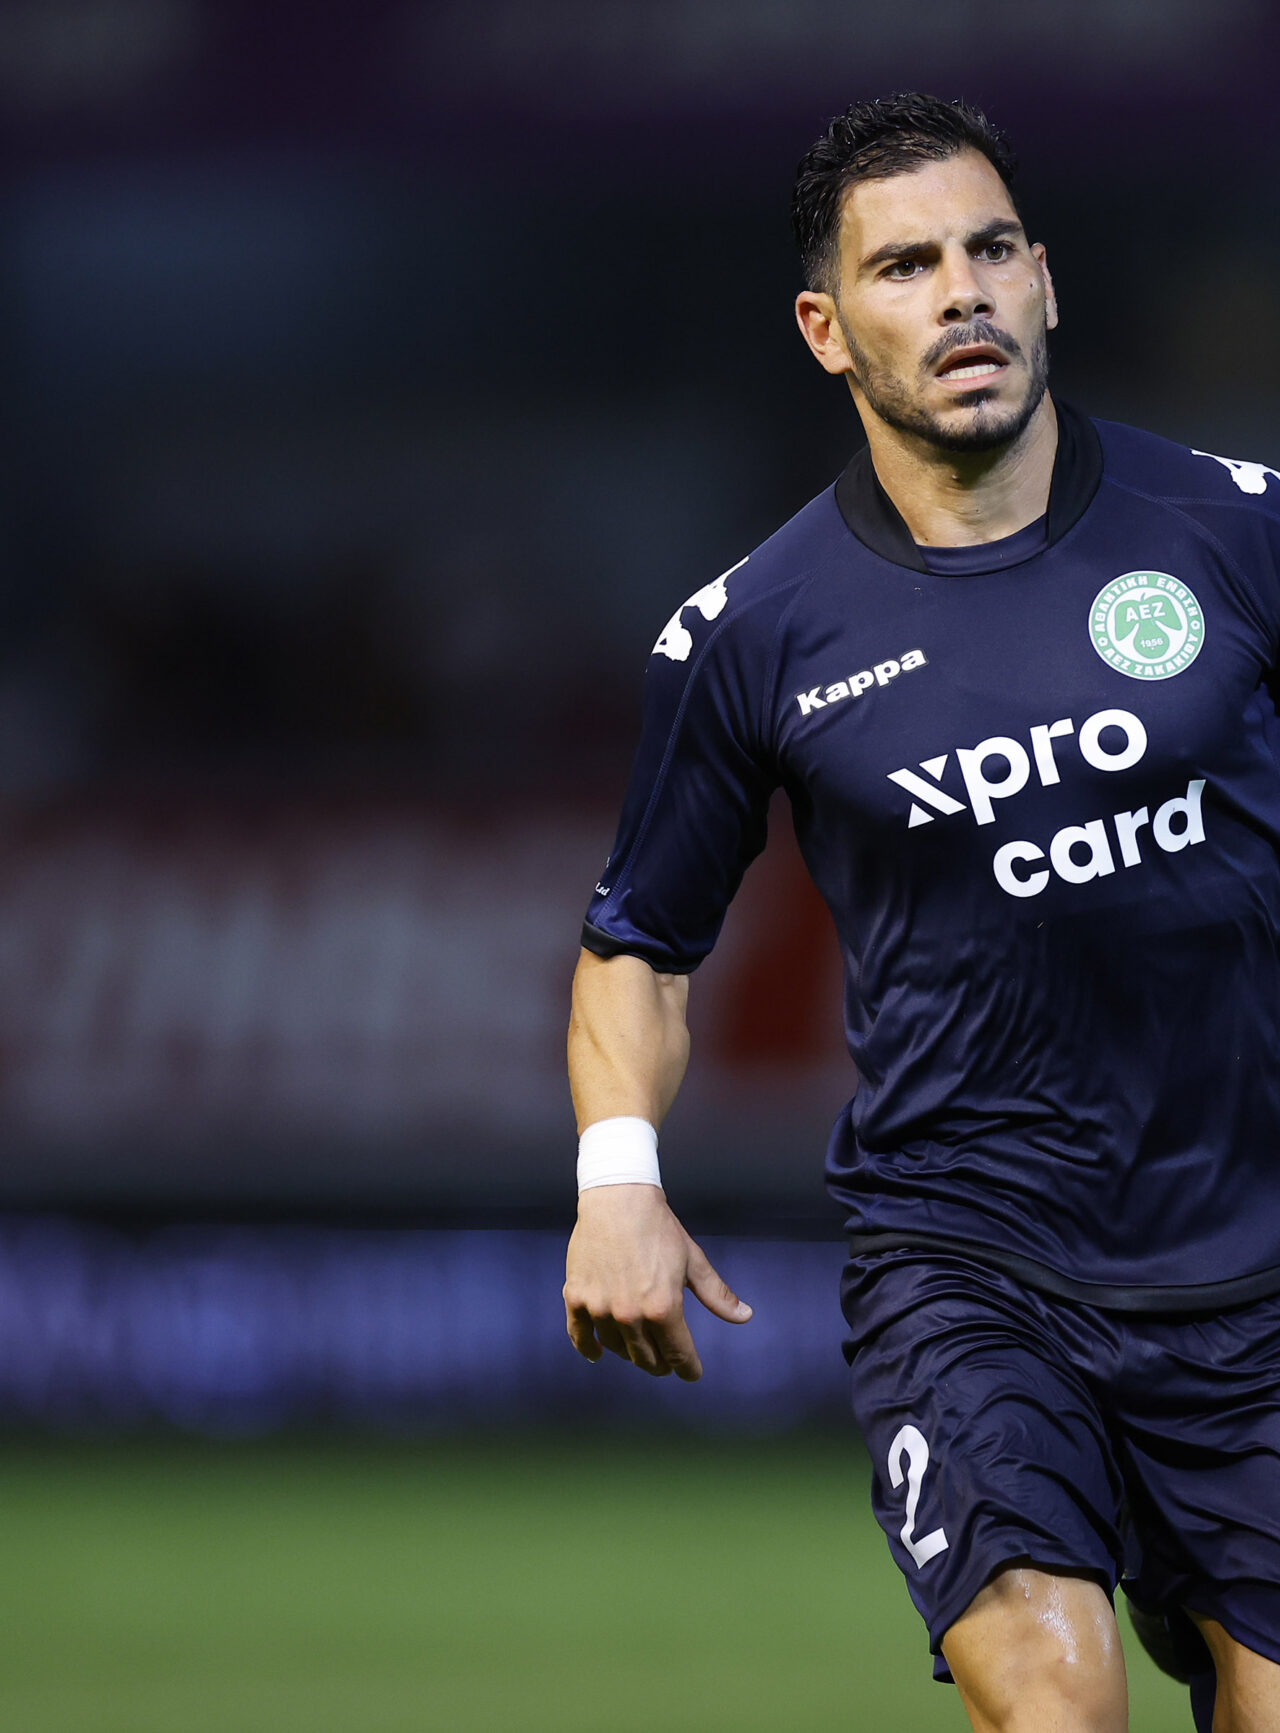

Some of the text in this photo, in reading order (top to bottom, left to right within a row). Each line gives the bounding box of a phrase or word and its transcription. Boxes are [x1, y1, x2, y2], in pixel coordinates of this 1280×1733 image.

[796, 649, 927, 716] Kappa
[1140, 637, 1164, 648] 1956
[886, 708, 1148, 829] xpro
[992, 779, 1206, 898] card
[888, 1424, 949, 1569] 2
